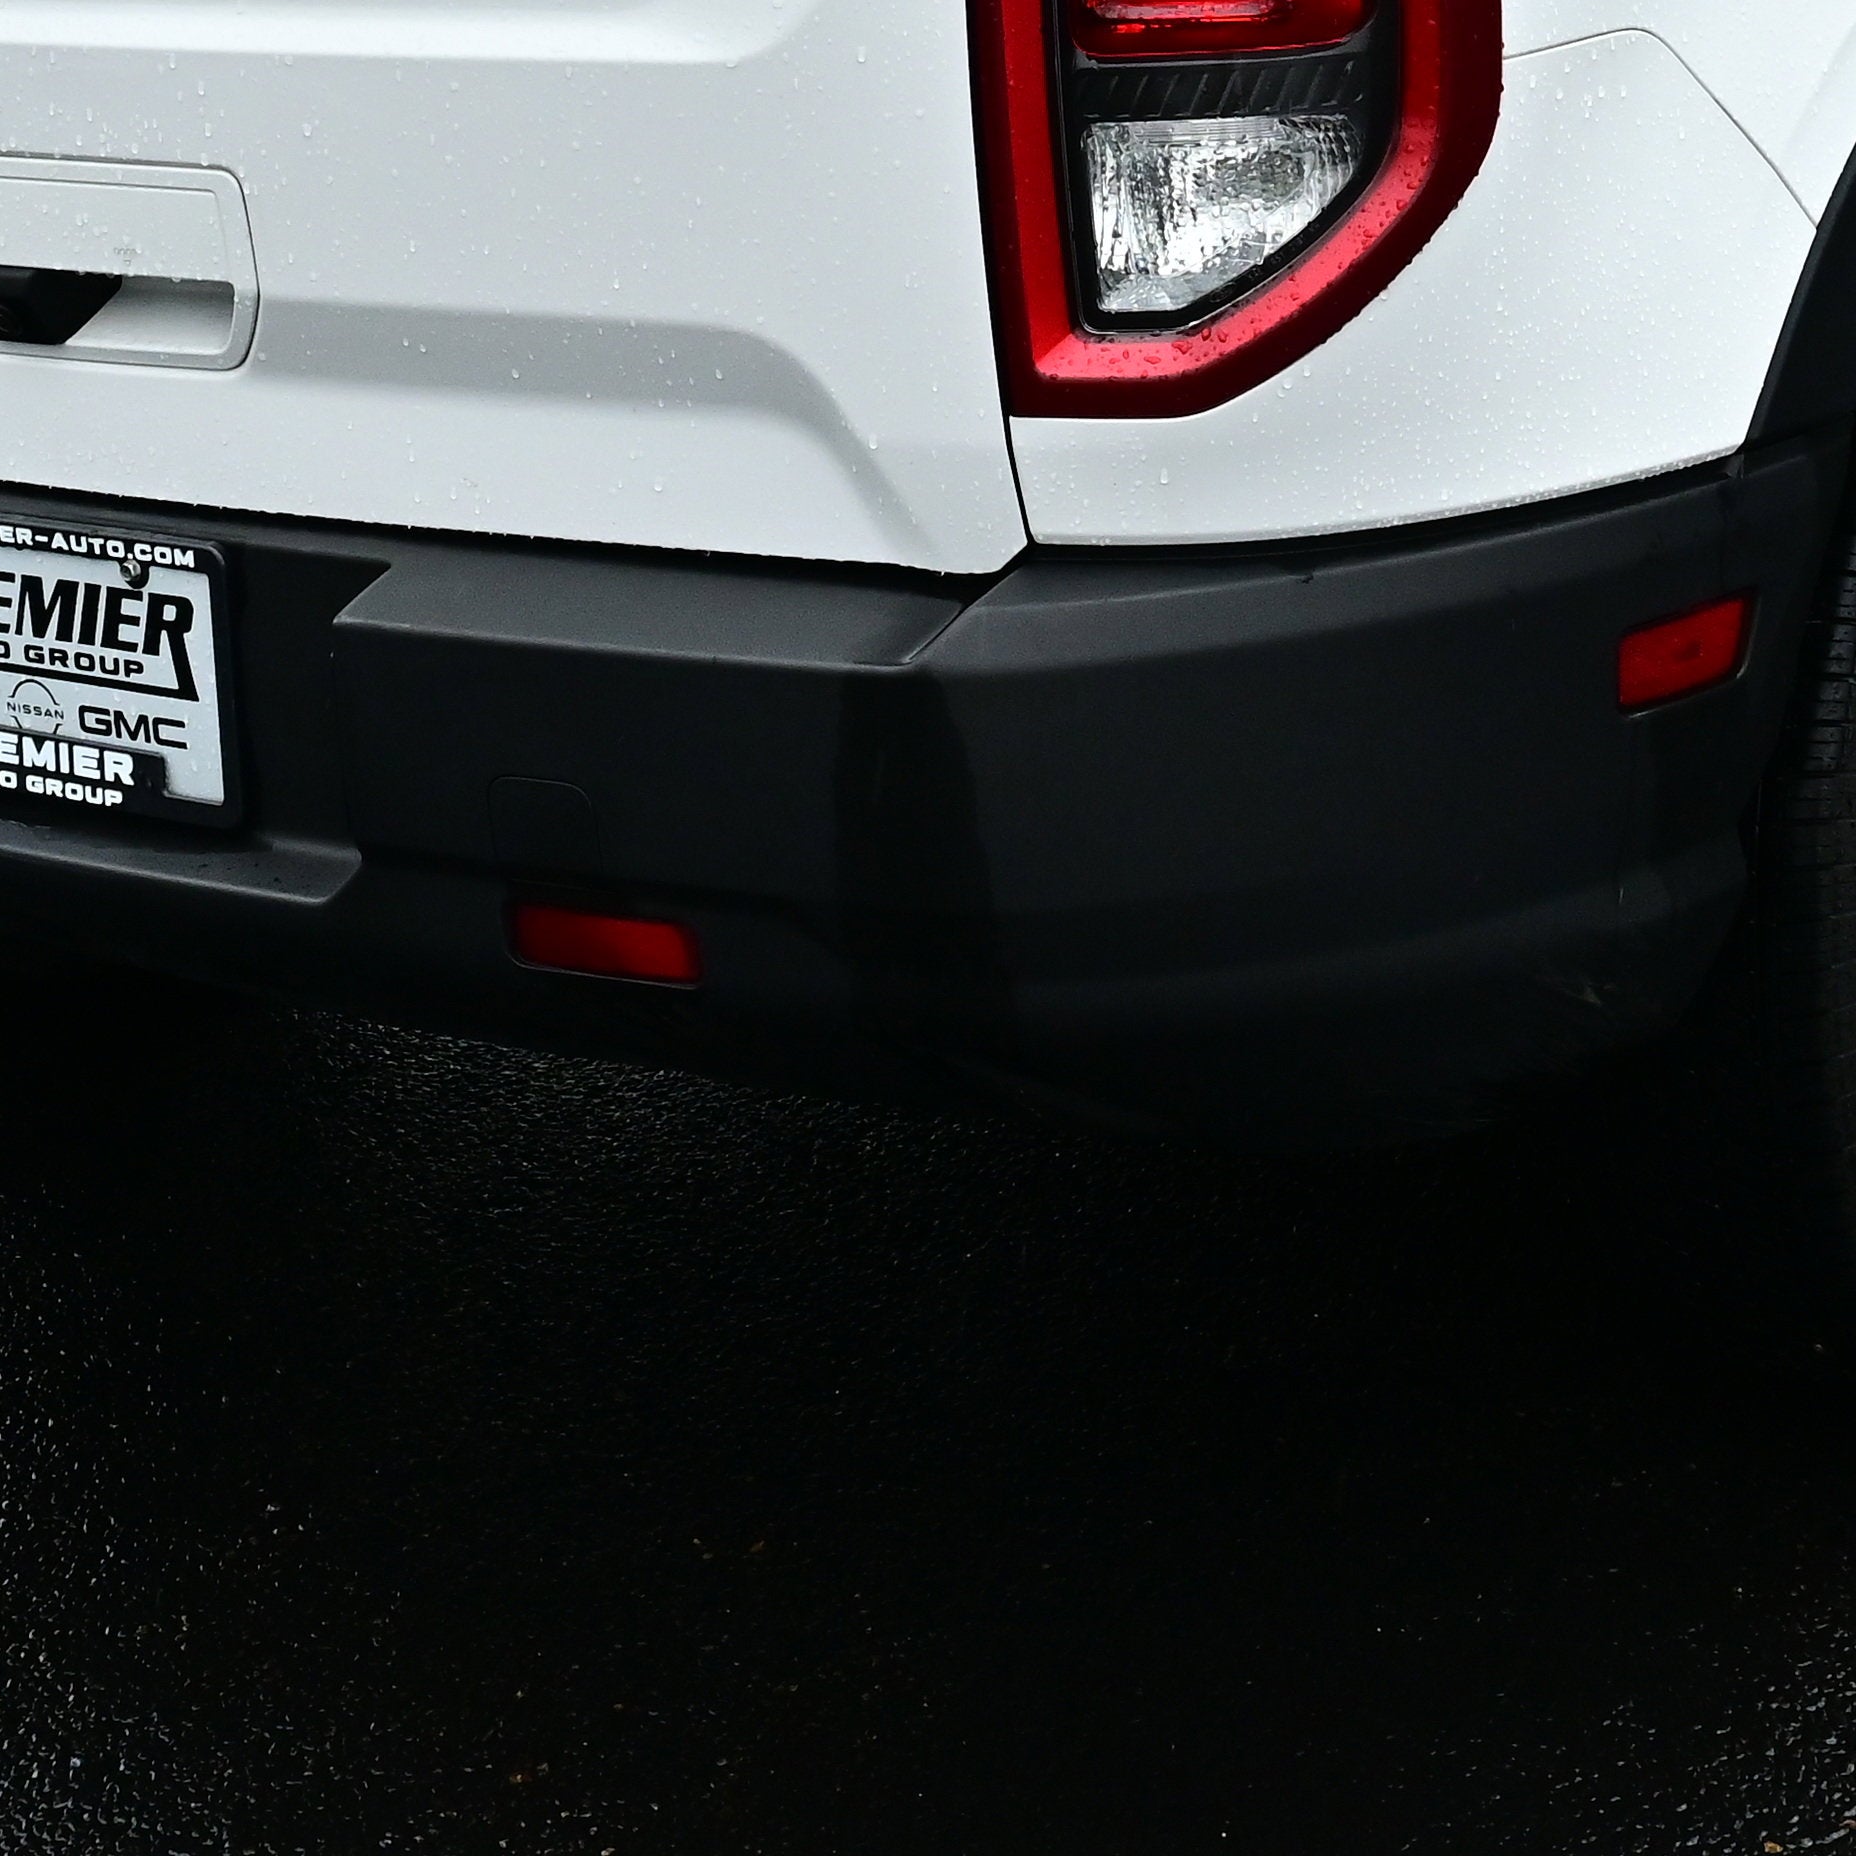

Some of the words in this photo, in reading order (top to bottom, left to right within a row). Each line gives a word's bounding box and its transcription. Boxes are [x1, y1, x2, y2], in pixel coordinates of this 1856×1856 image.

[23, 644, 145, 678] GROUP
[6, 700, 65, 721] NISSAN
[78, 704, 189, 750] GMC
[25, 774, 124, 807] GROUP
